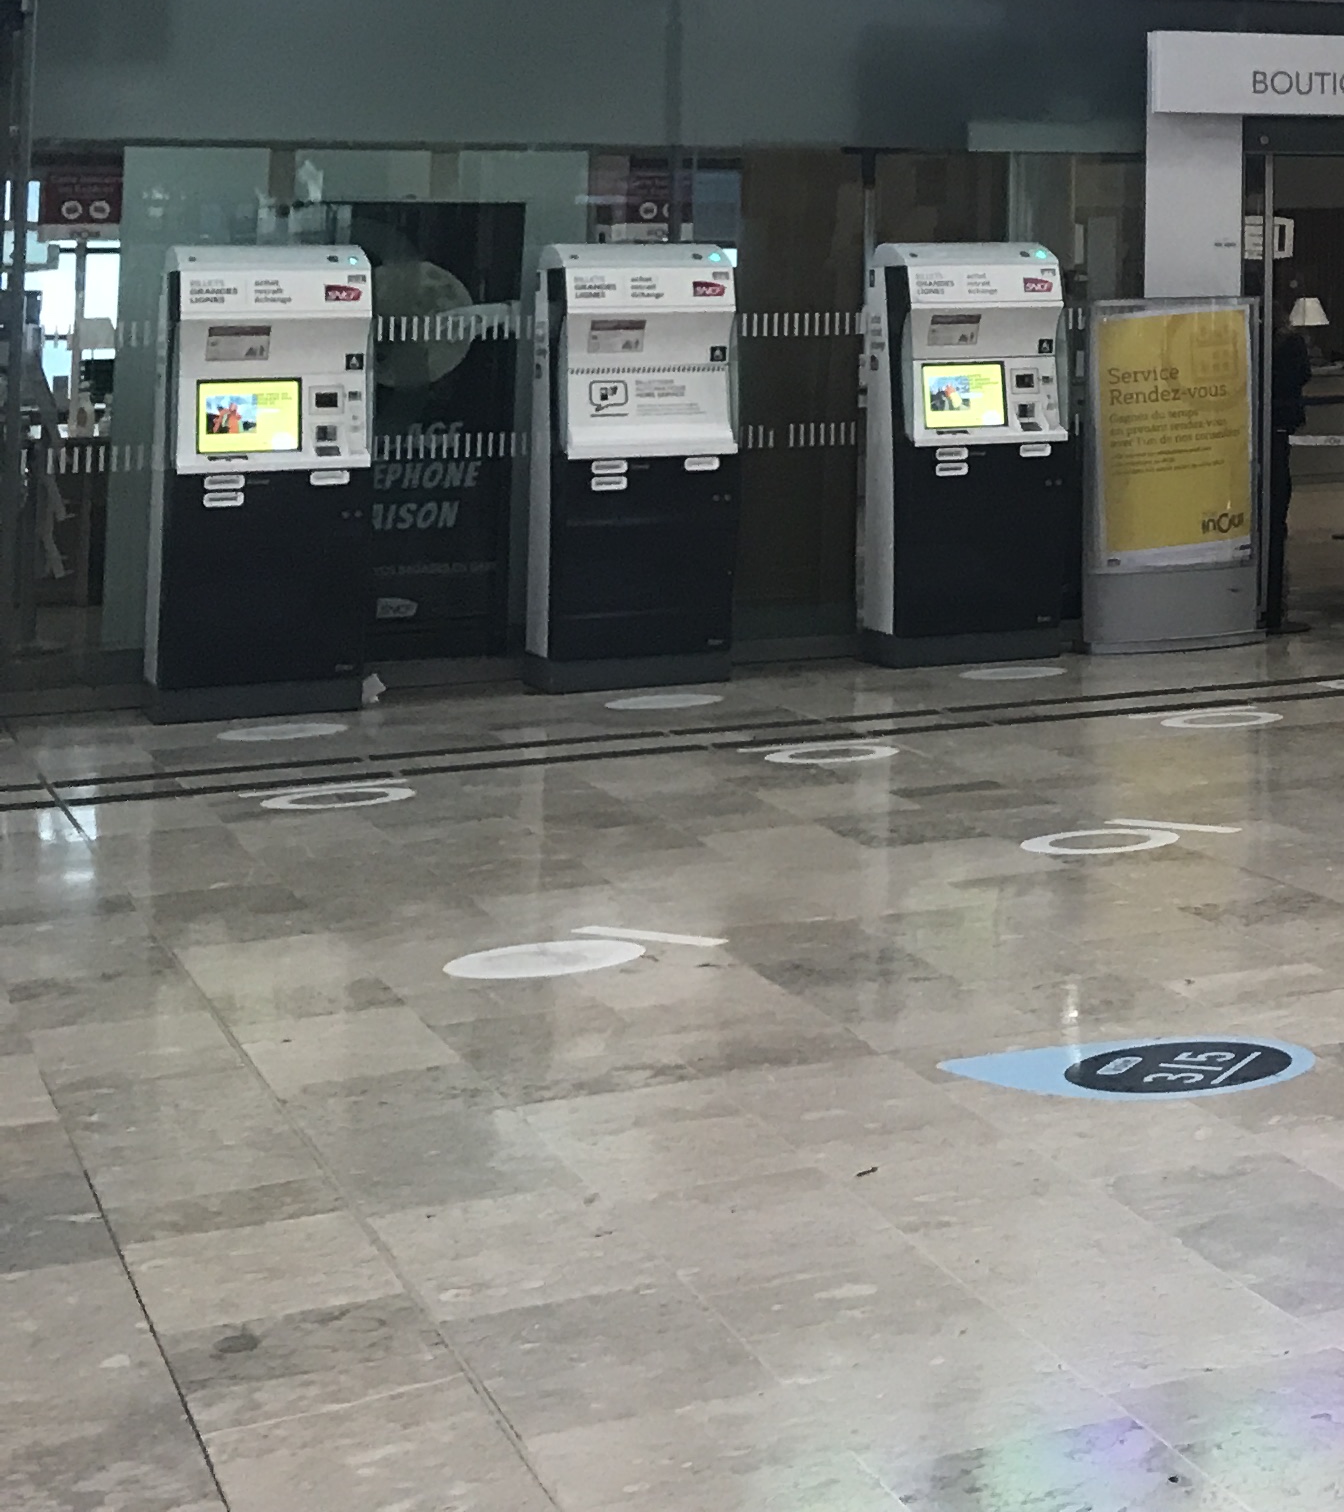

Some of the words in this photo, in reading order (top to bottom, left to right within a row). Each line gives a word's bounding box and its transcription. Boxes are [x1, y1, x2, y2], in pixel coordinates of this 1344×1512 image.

[1108, 367, 1179, 385] Service
[1109, 384, 1228, 406] Rendez-vous
[1168, 409, 1200, 421] temps
